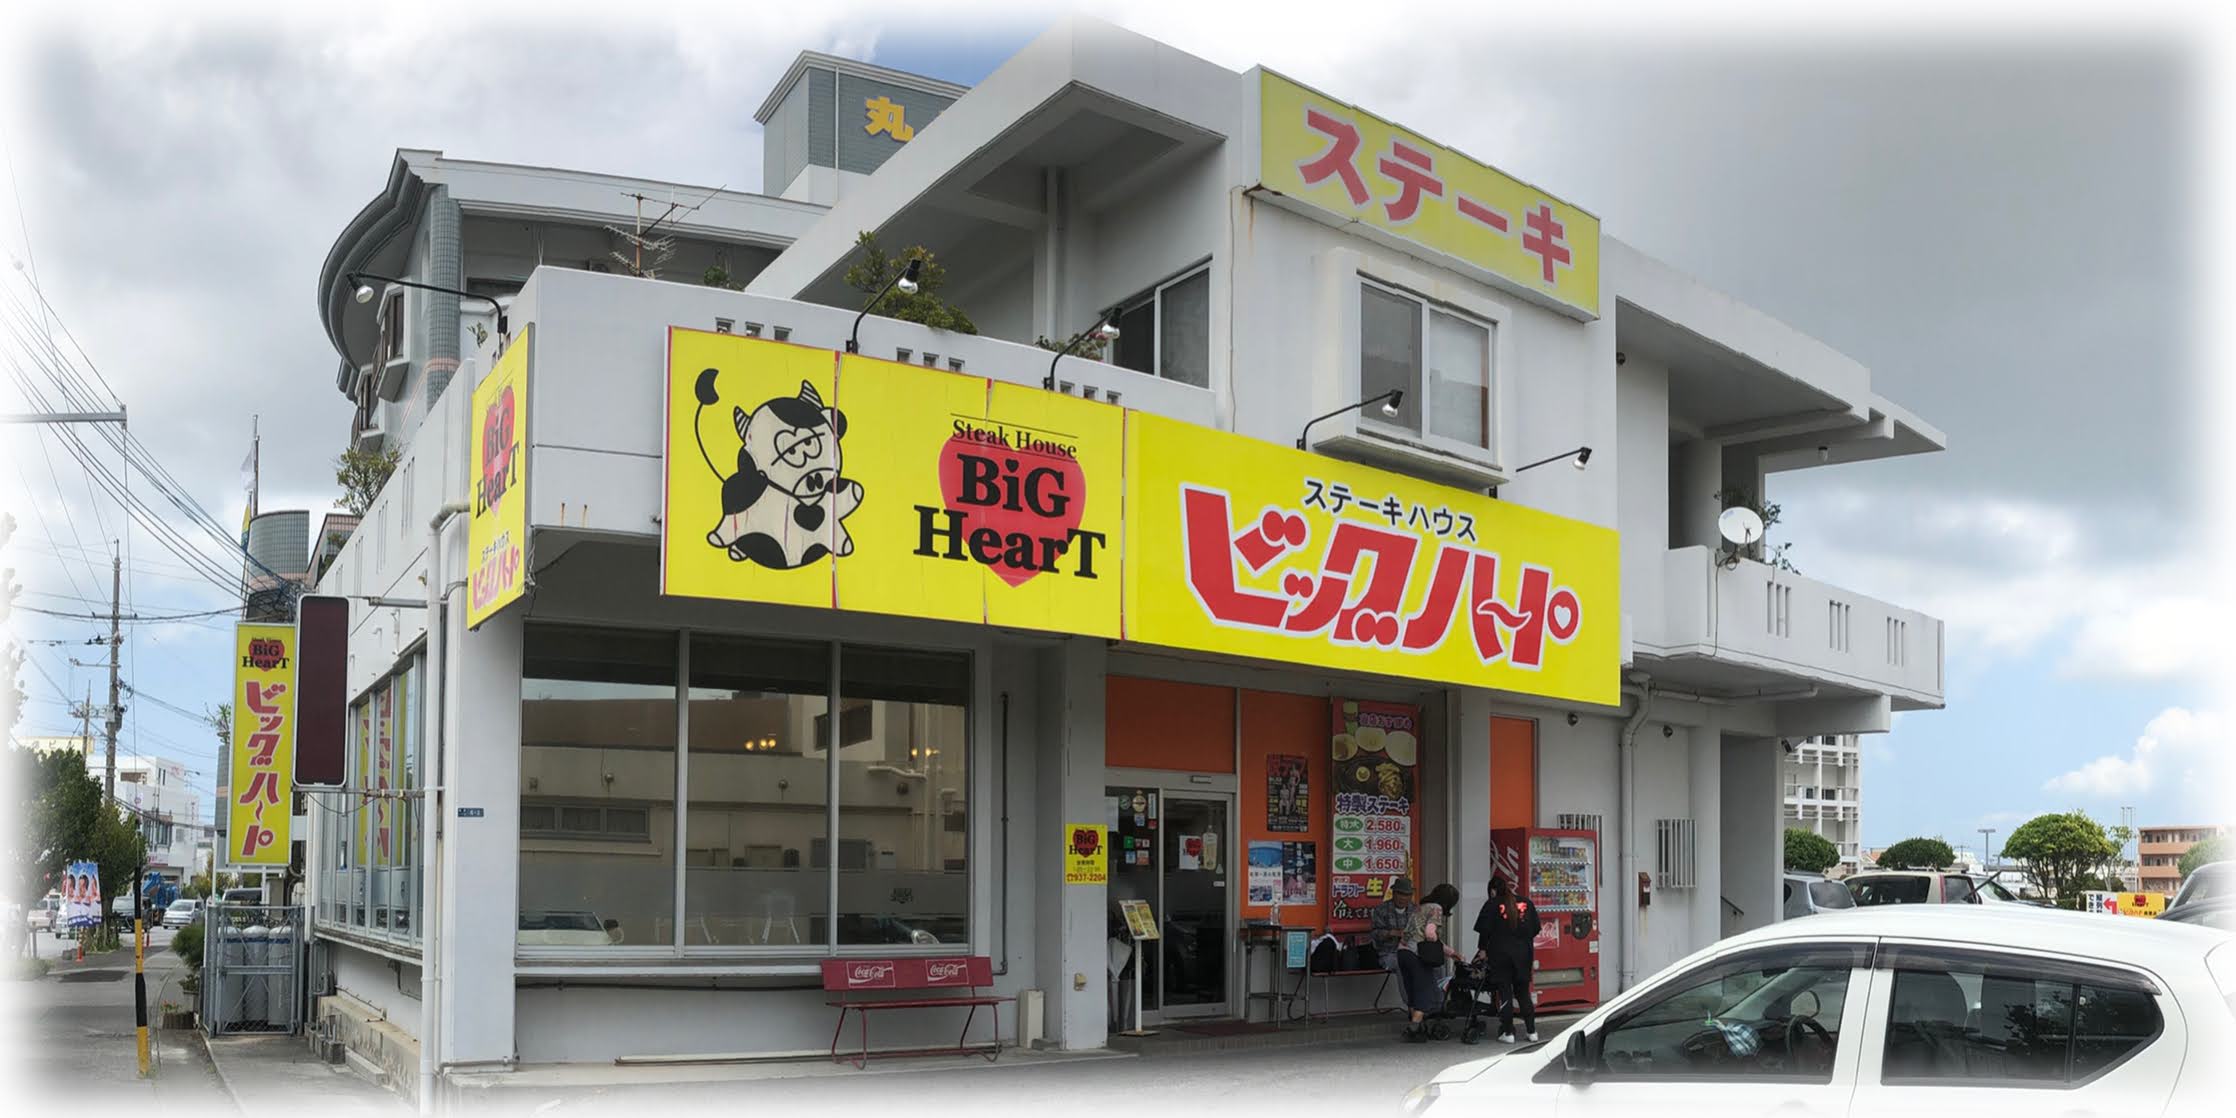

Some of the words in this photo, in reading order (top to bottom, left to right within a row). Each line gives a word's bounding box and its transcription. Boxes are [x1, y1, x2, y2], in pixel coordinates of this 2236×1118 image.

[864, 96, 914, 141] 丸
[1298, 108, 1571, 284] ステーキ
[952, 418, 1011, 452] Steak
[1015, 430, 1078, 459] House
[956, 452, 1071, 519] BiG
[1304, 480, 1477, 542] ステーキハウス
[1183, 487, 1581, 667] ビッグハート
[238, 680, 287, 857] ビッグハート
[1336, 793, 1410, 815] 特製ステーキ
[1343, 839, 1354, 849] 大
[1343, 858, 1353, 869] 中
[1366, 877, 1384, 898] 生
